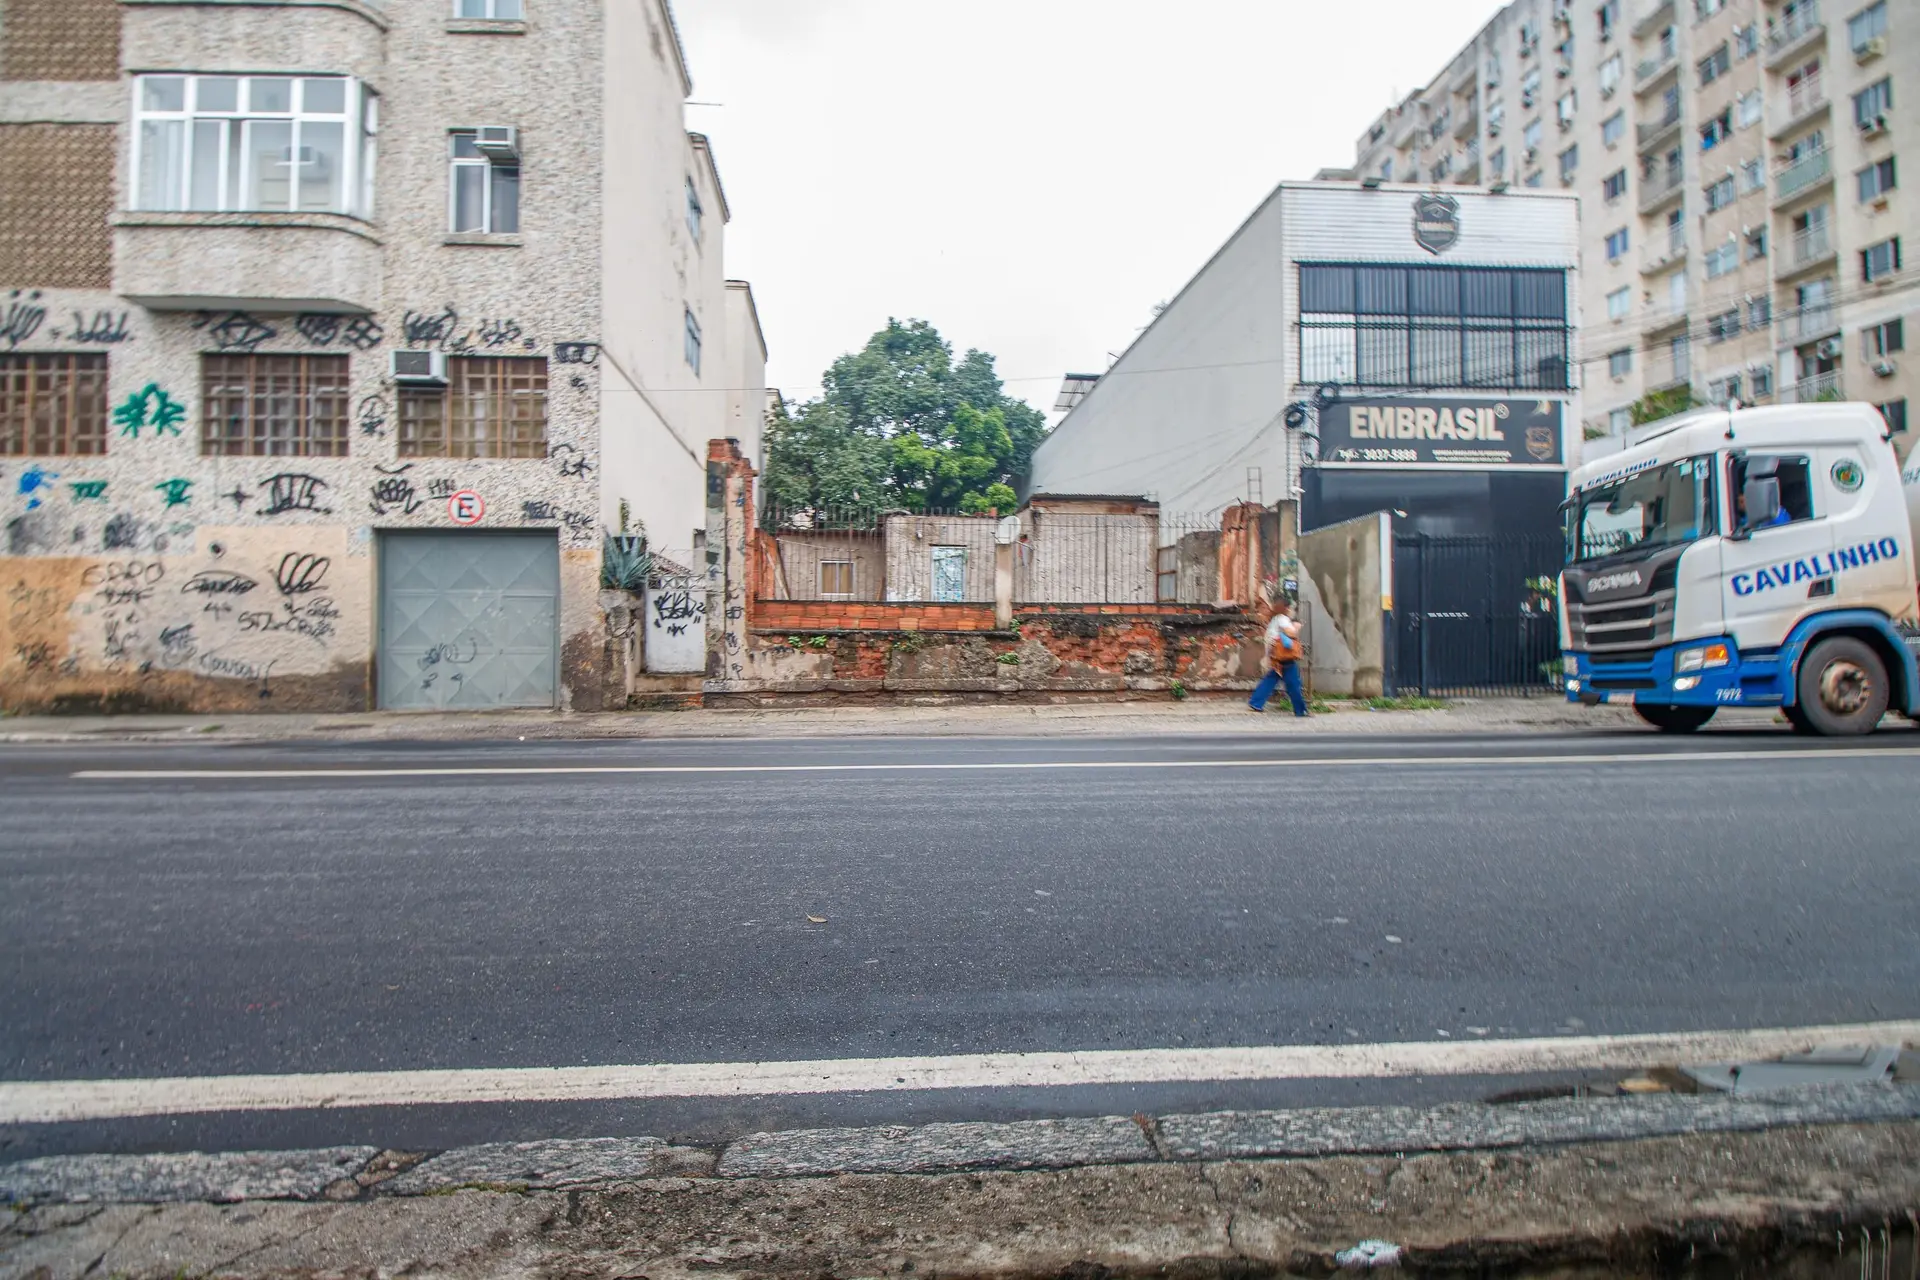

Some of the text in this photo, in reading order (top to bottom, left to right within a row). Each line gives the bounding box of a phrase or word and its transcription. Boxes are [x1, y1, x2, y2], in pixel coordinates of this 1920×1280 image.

[1587, 457, 1659, 488] CAVALINHO
[458, 497, 475, 518] E
[1731, 537, 1900, 596] CAVALINHO
[1588, 570, 1642, 593] SCANIA
